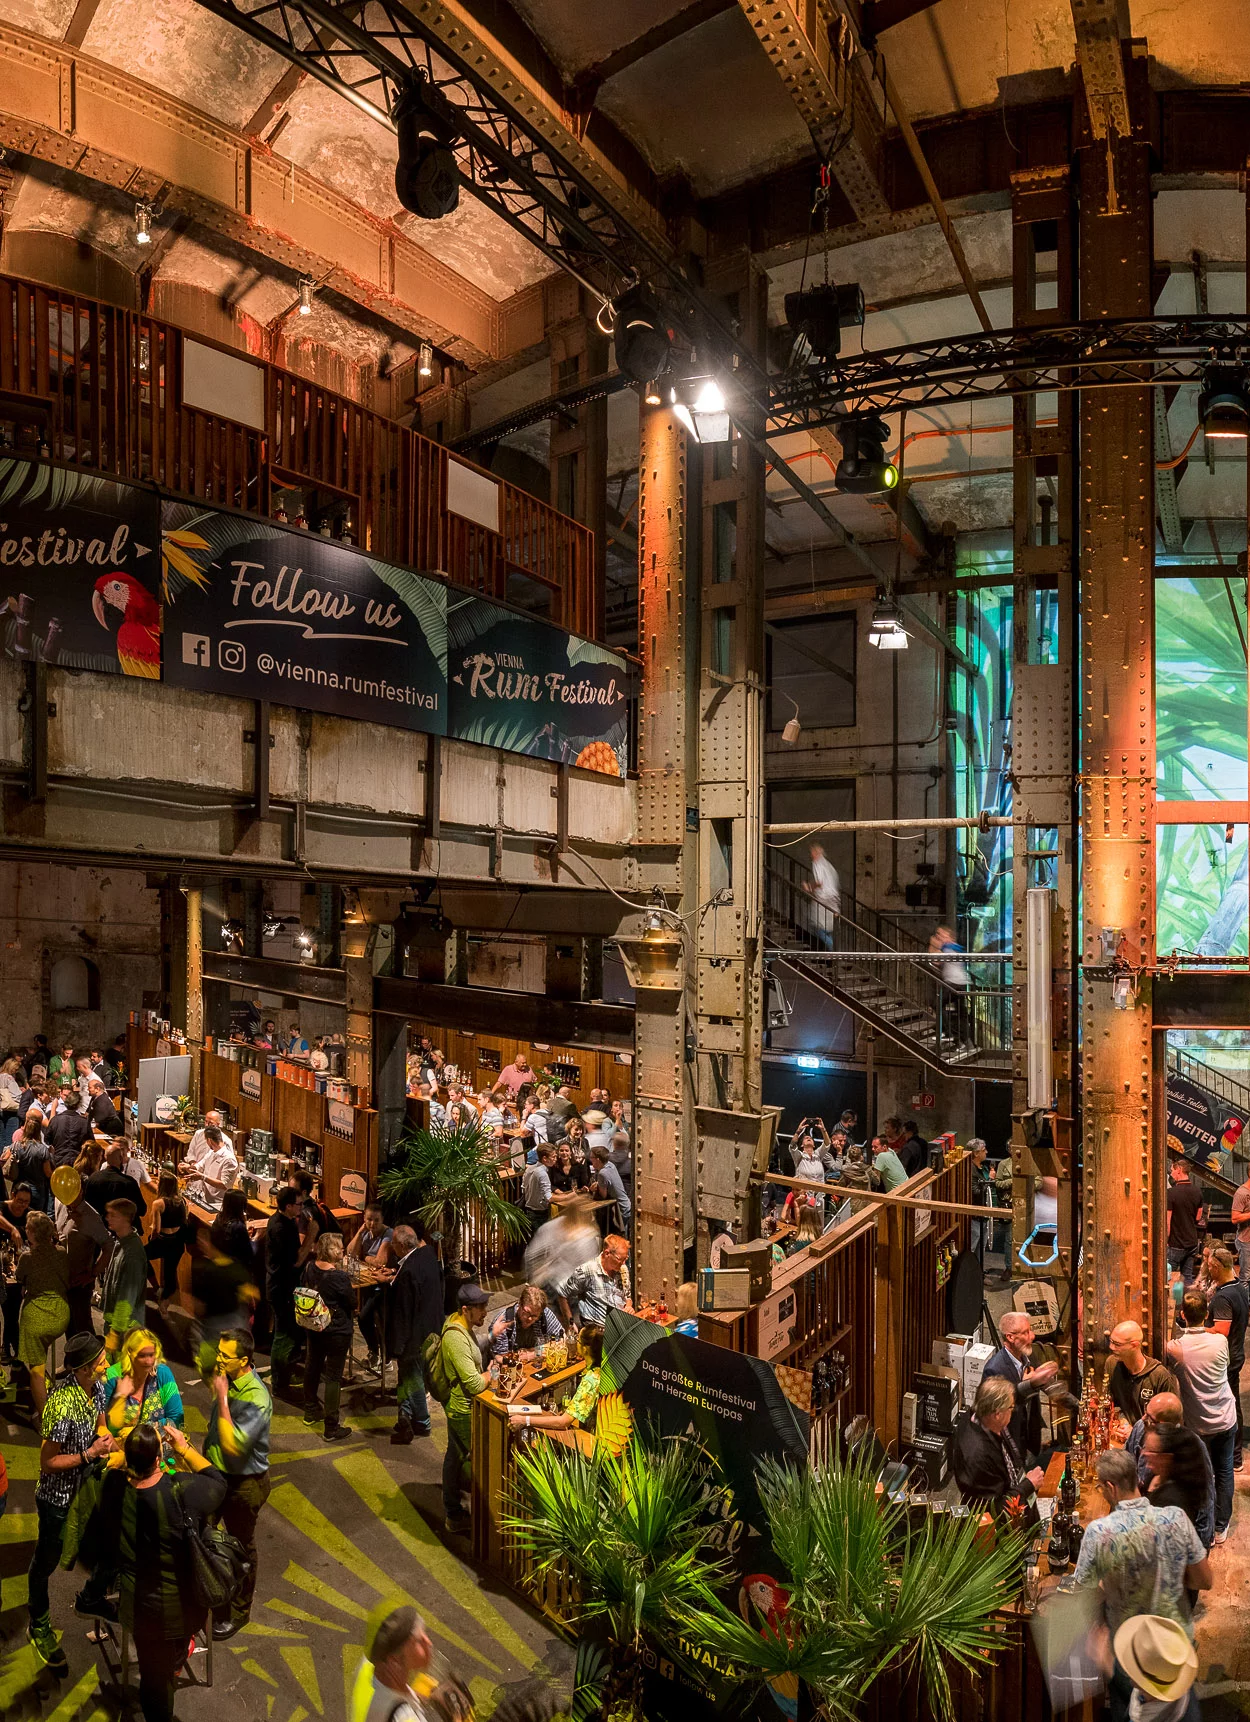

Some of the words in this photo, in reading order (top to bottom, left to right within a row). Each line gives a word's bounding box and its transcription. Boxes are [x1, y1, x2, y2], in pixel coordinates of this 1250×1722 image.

[0, 523, 129, 567] estival
[231, 560, 356, 620] Follow
[364, 598, 402, 628] us
[256, 652, 439, 711] @vienna.rumfestival
[463, 652, 543, 702] Rum
[544, 672, 616, 706] Festival
[494, 651, 525, 670] VIENNA
[1173, 1115, 1217, 1147] WEITER
[642, 1360, 660, 1375] Das
[661, 1369, 694, 1388] größte
[695, 1381, 756, 1411] Rumfestival
[651, 1377, 664, 1391] im
[666, 1384, 699, 1406] Herzen
[701, 1398, 743, 1421] Europas
[705, 1690, 716, 1702] us
